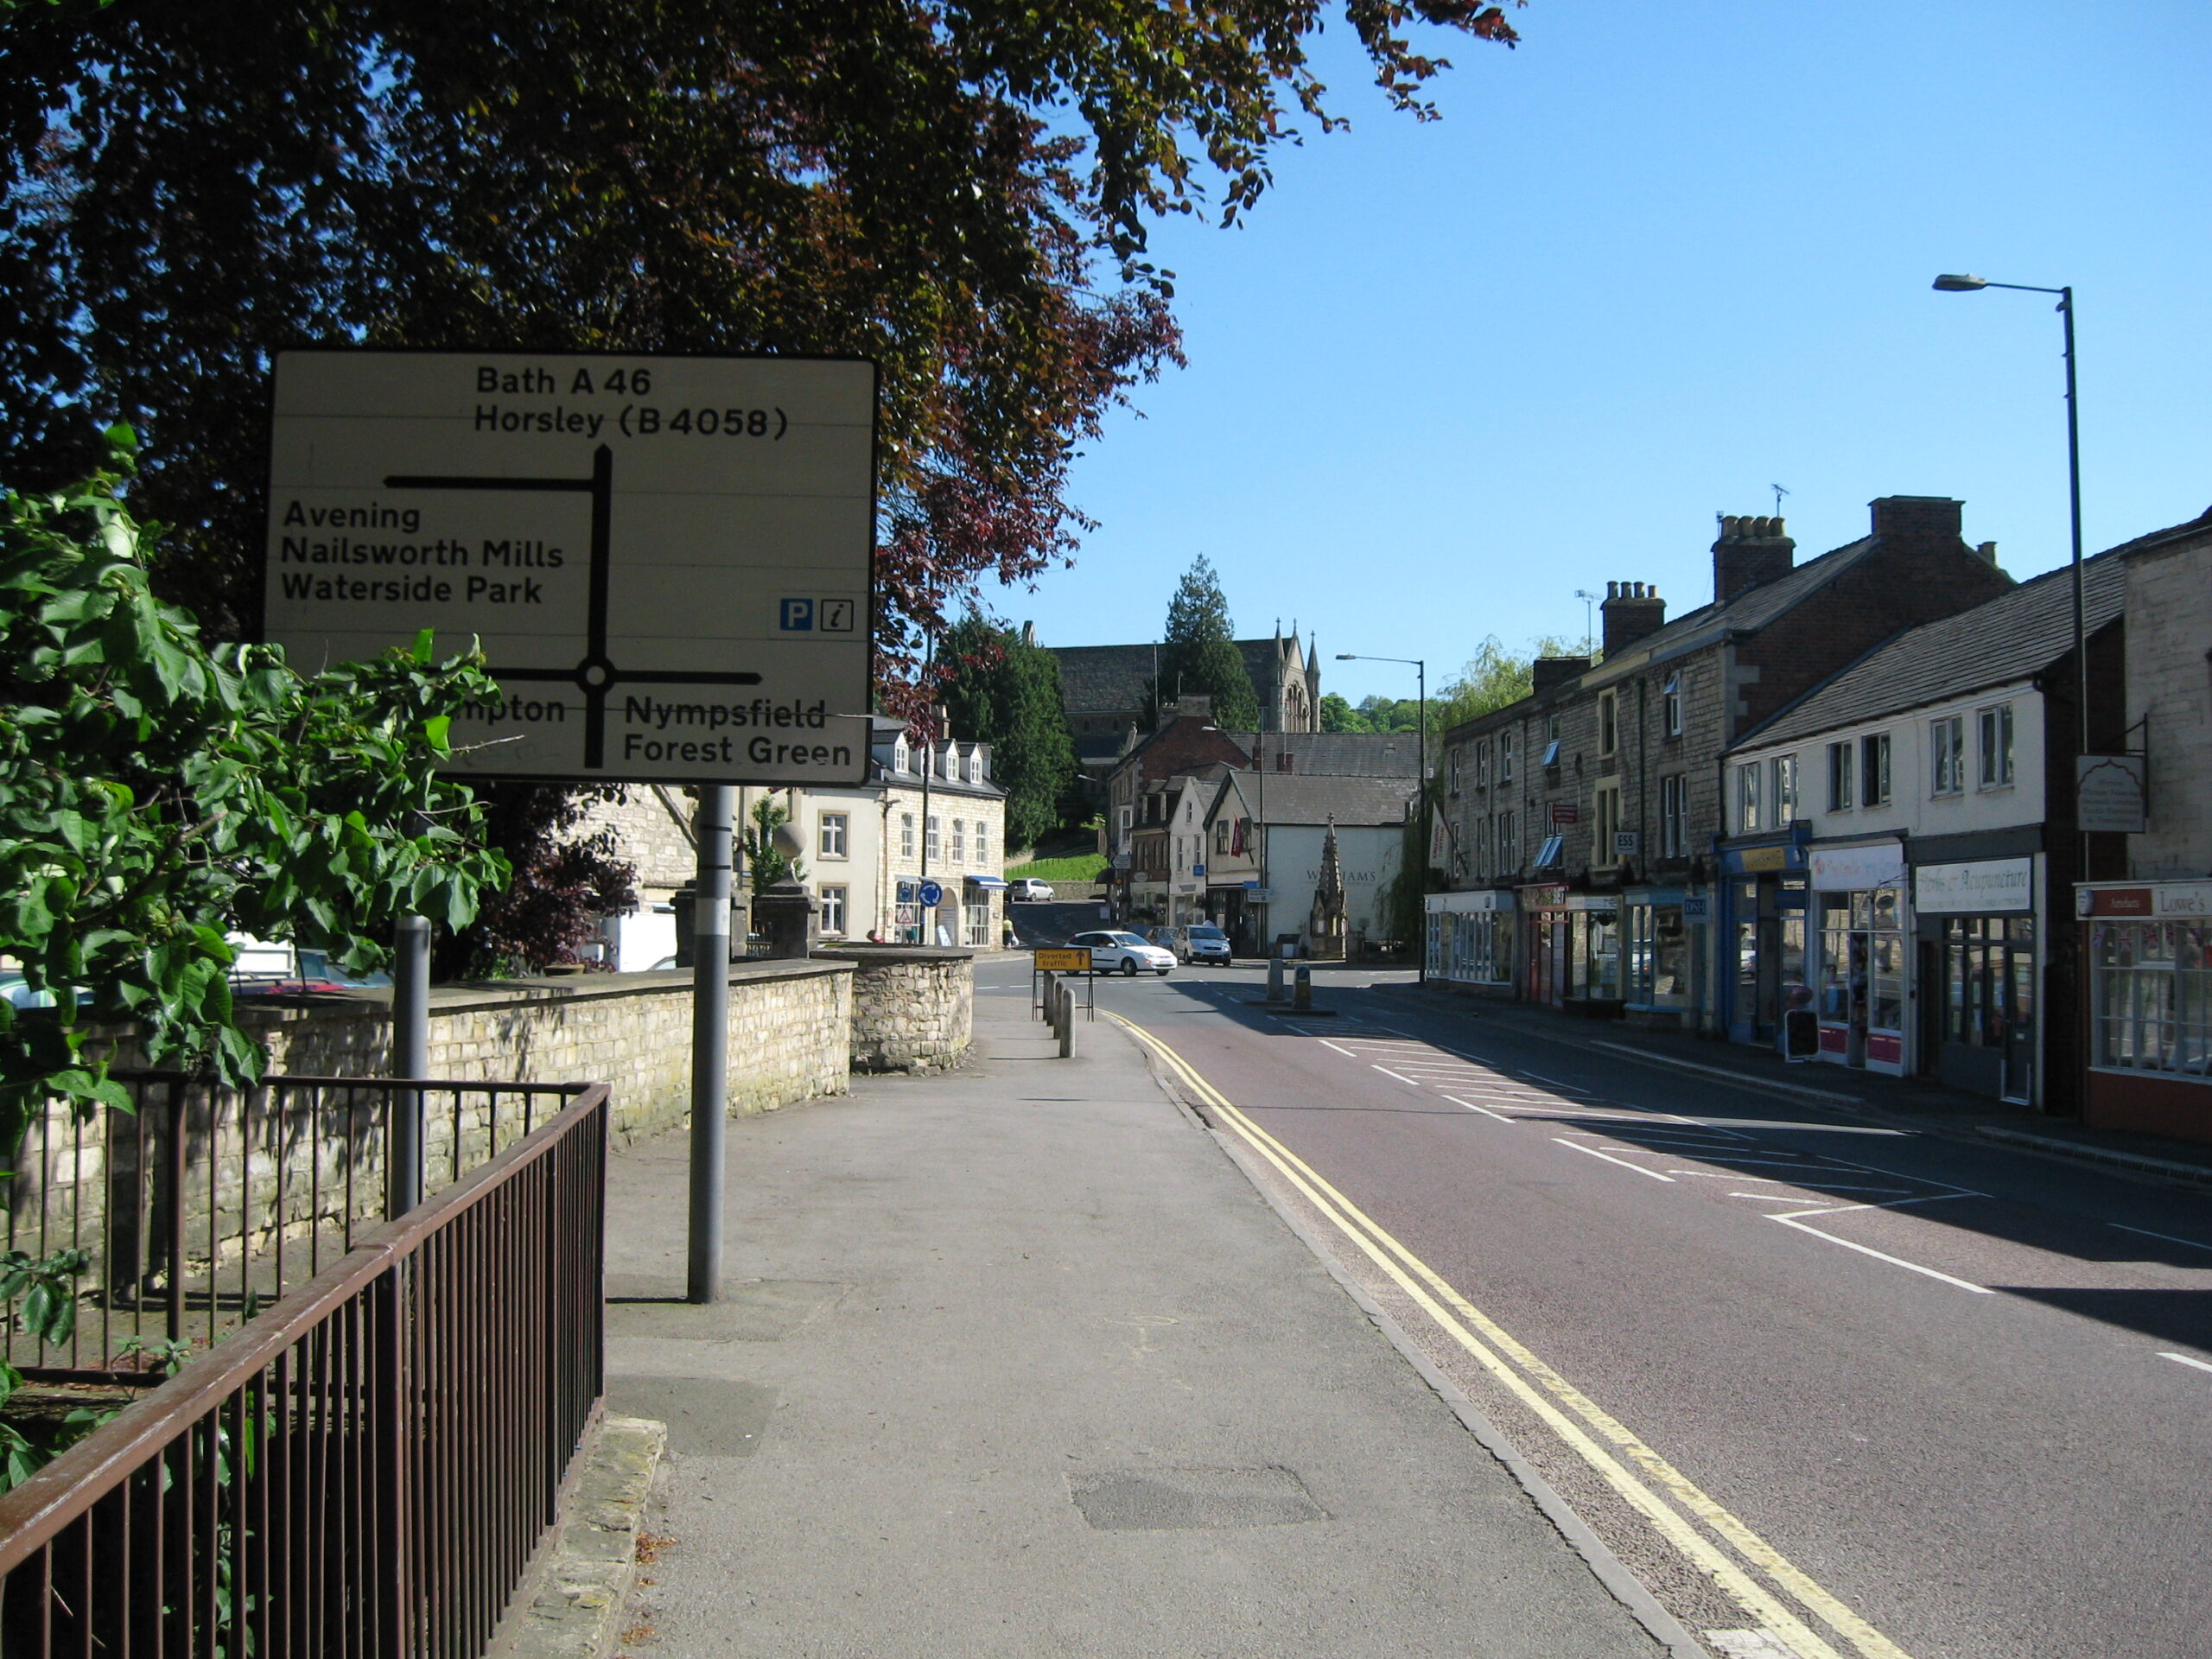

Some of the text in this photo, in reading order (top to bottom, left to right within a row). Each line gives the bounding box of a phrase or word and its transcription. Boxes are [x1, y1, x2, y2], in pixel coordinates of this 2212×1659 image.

[477, 366, 555, 393] Bath
[474, 404, 605, 439] Horsley
[283, 500, 420, 533] Avening
[280, 537, 563, 568] Nailsworth Mills
[281, 573, 543, 603] Waterside Park
[625, 696, 825, 731] Nympsfield
[625, 734, 851, 766] Forest Green
[1961, 869, 2027, 898] Acupuncture
